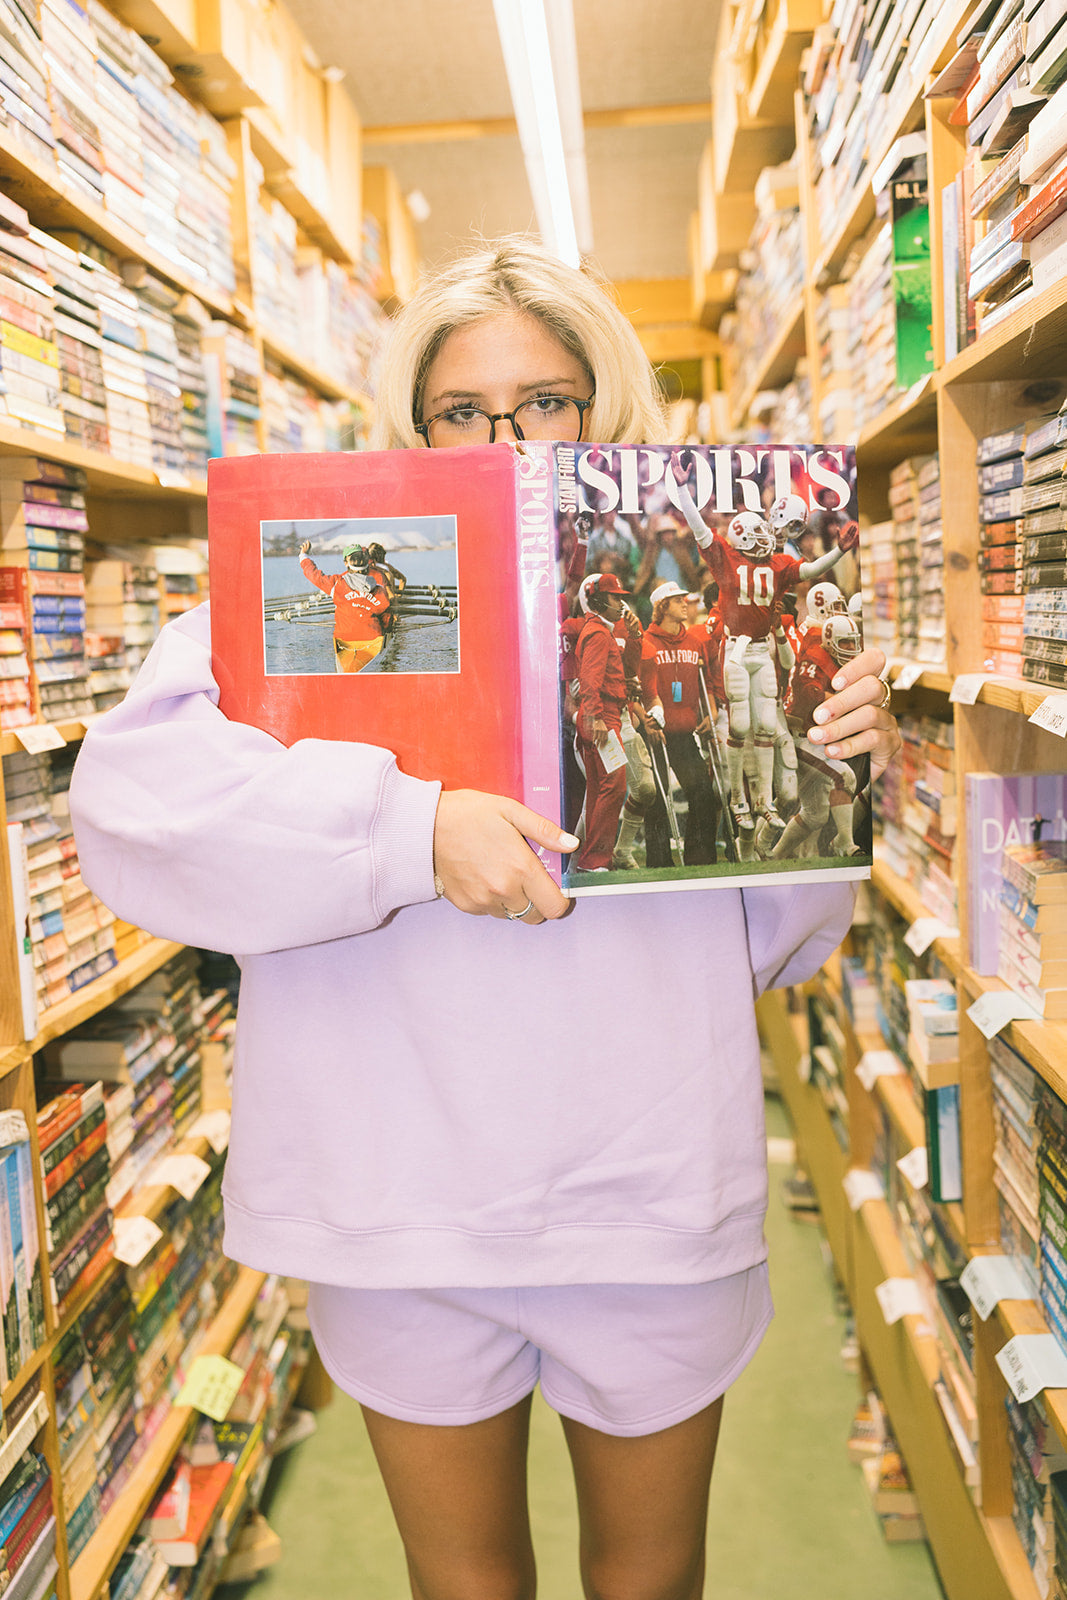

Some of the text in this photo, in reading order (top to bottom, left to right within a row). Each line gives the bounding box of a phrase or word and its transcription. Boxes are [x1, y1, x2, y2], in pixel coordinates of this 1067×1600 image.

[557, 447, 577, 513] STANFORD
[577, 448, 851, 514] SPORTS
[519, 454, 550, 588] SPORTS
[736, 565, 774, 607] 10
